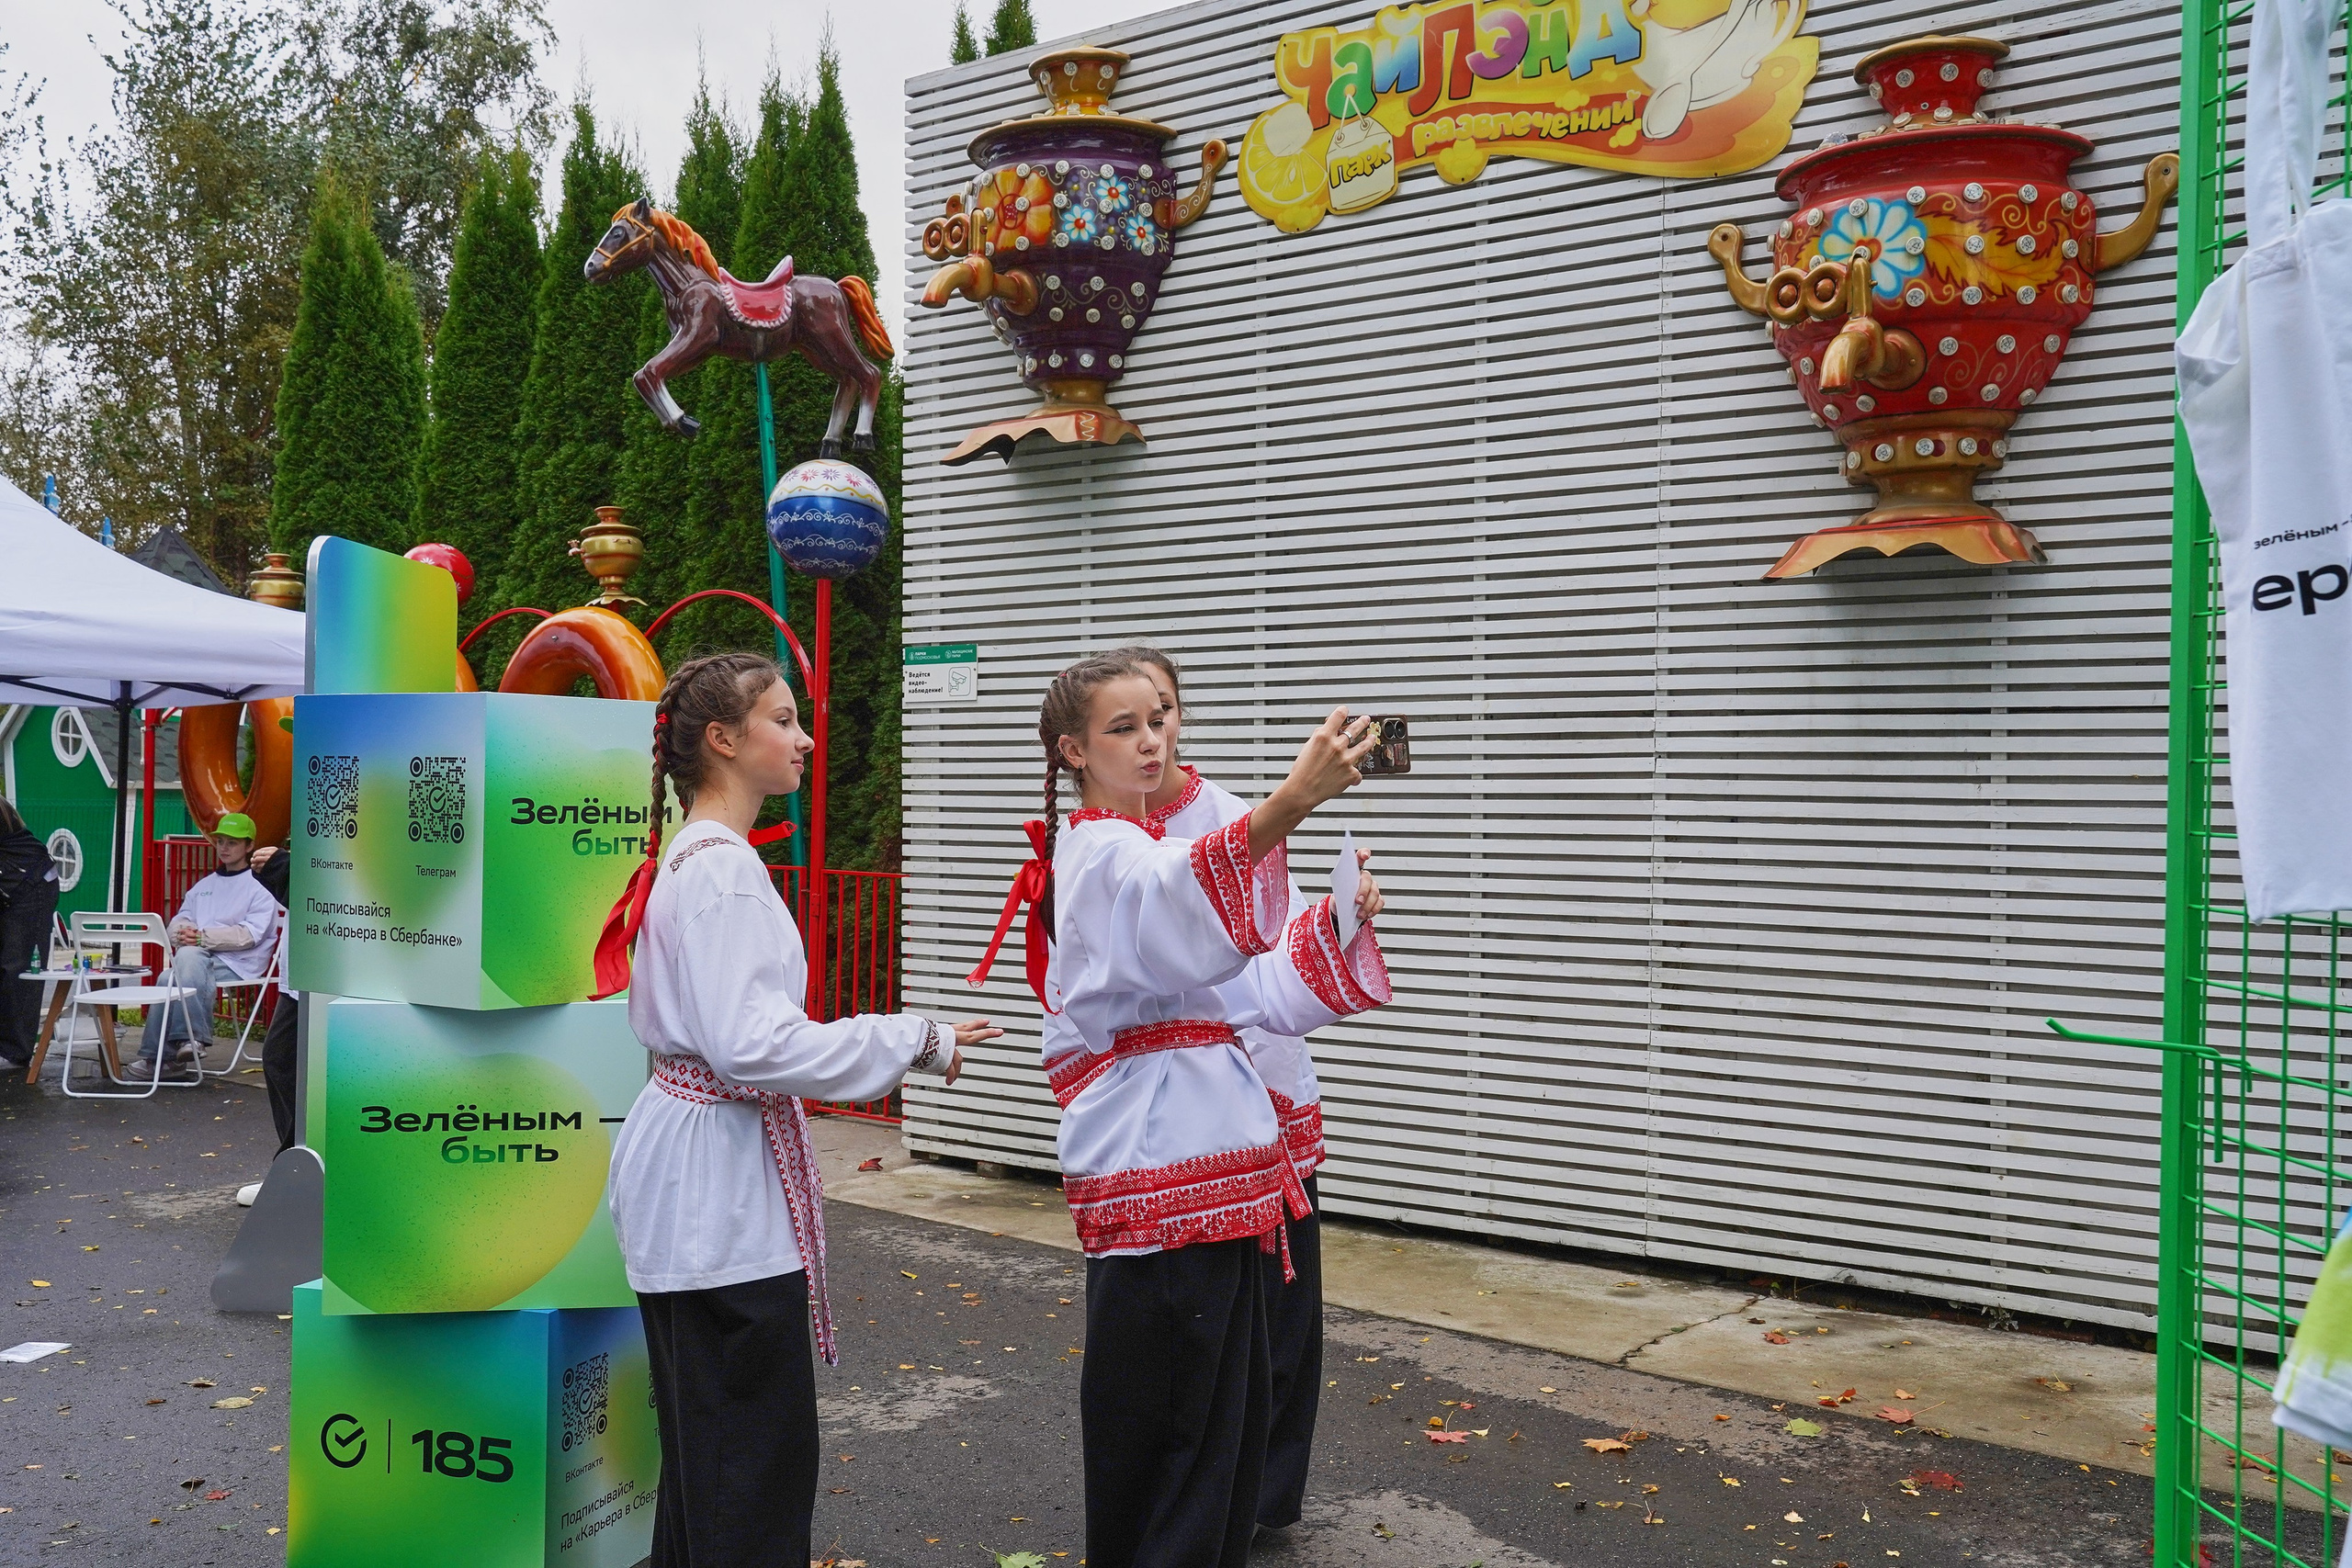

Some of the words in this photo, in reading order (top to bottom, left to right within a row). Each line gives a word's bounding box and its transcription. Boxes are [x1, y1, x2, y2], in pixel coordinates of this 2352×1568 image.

[1411, 89, 1641, 158] развлечений
[2254, 523, 2338, 550] зелёным
[311, 857, 354, 871] ВКонтакте
[415, 865, 457, 879] Телеграм
[306, 897, 391, 918] Подписывайся
[306, 923, 319, 935] на
[322, 921, 377, 942] «Карьера
[379, 930, 387, 941] в
[390, 927, 463, 947] Сбербанке»
[359, 1104, 582, 1134] Зелёным
[441, 1135, 560, 1164] быть
[412, 1429, 514, 1483] 185
[565, 1456, 605, 1483] ВКонтакте
[560, 1480, 635, 1530] Подписывайся
[560, 1537, 573, 1553] на
[575, 1508, 623, 1544] «Карьера
[625, 1504, 631, 1517] в
